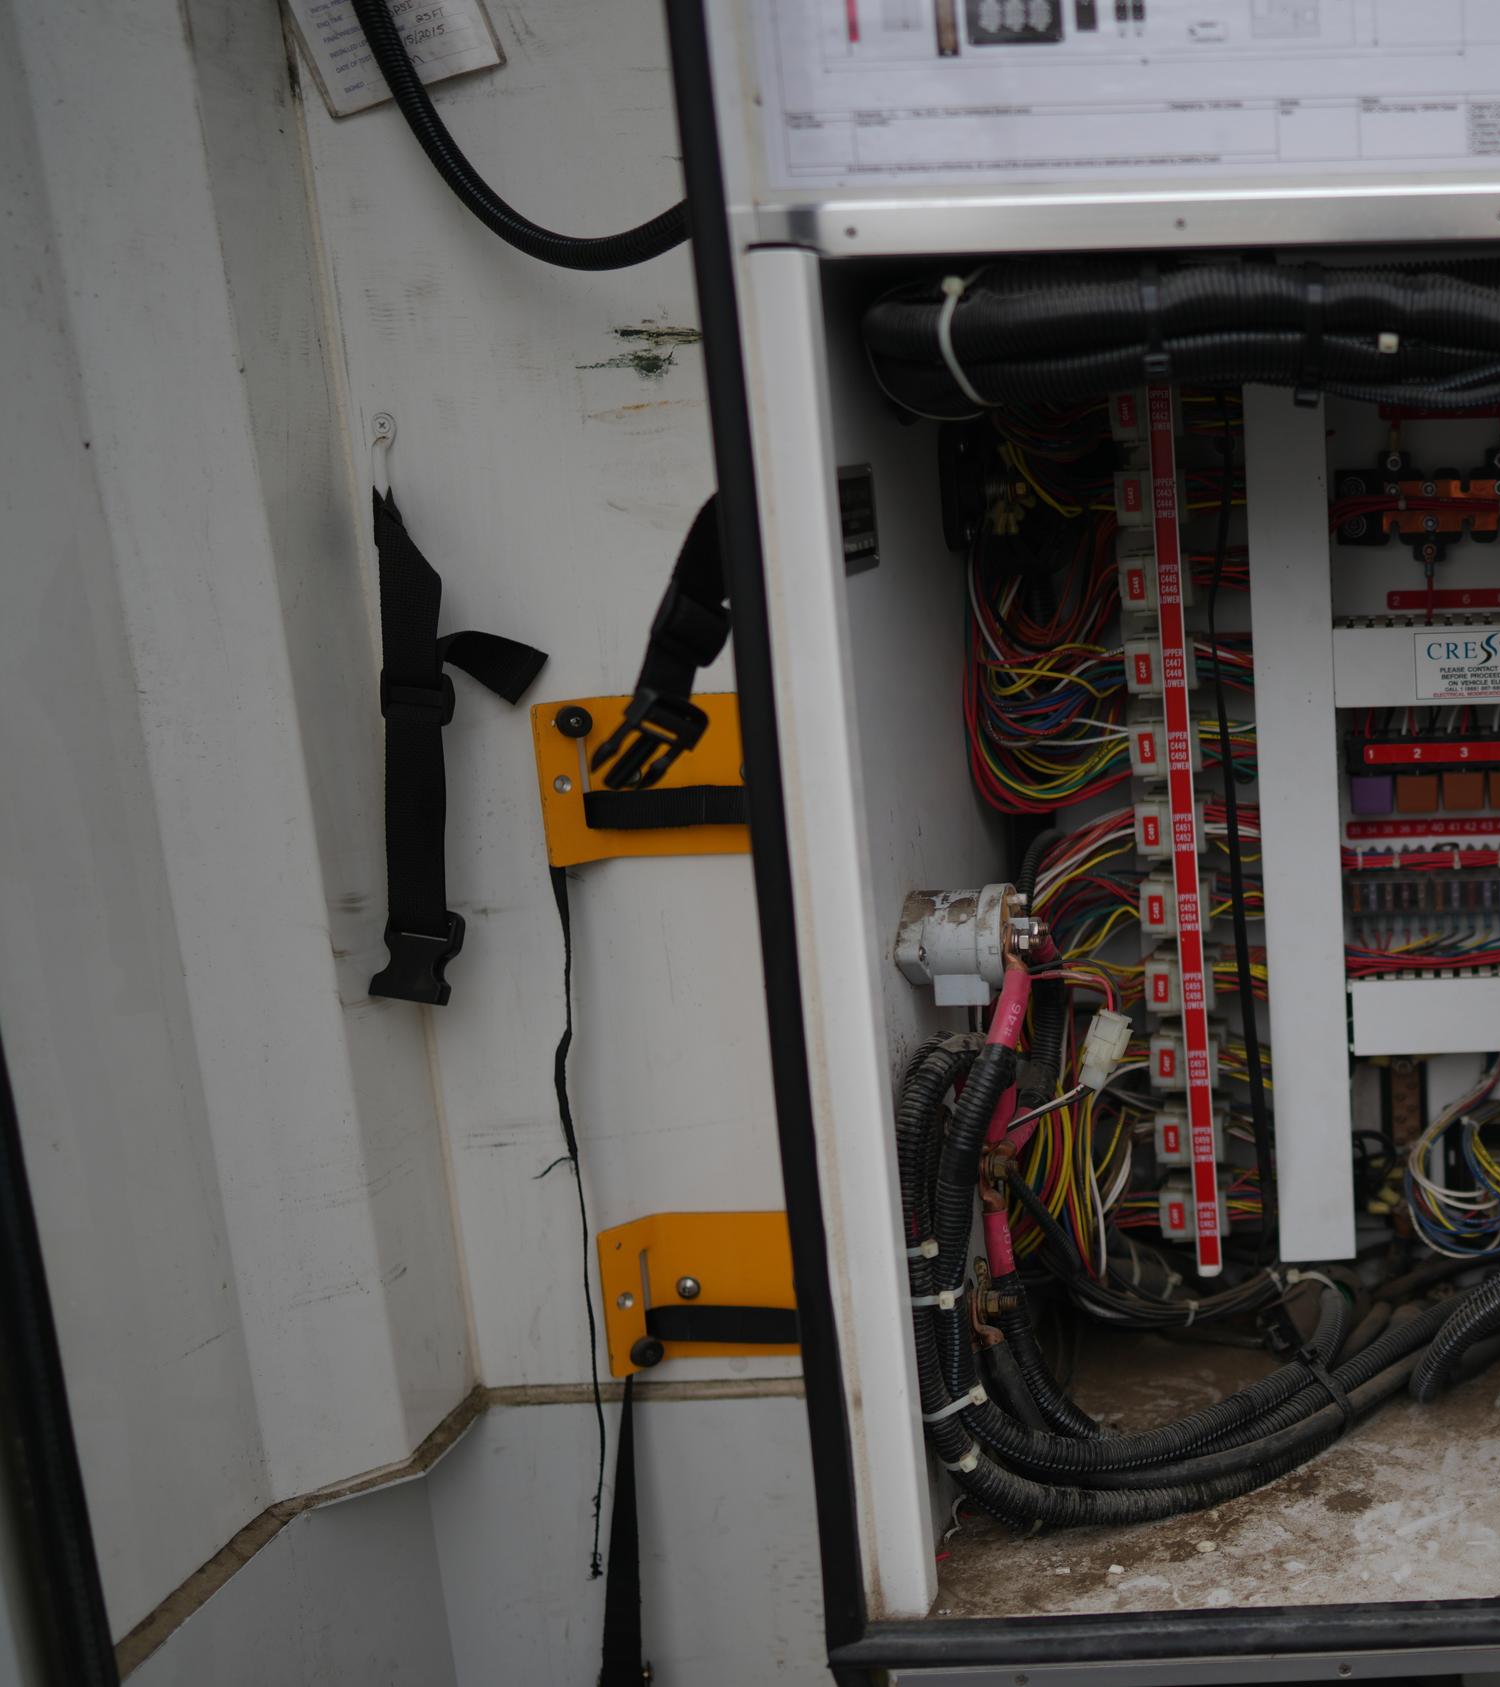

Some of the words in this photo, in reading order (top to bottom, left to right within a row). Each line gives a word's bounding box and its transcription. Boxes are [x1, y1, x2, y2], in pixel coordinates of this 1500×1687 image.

[1153, 479, 1174, 488] UPPER
[1158, 564, 1178, 573] UPPER
[1160, 574, 1177, 583] C445
[1161, 584, 1178, 594] C446
[1160, 595, 1180, 604] LOWER
[1392, 595, 1400, 606] 2
[1462, 593, 1470, 604] 6
[1163, 648, 1183, 657] UPPER
[1165, 658, 1181, 667] C447
[1165, 679, 1185, 688] LOWER
[1168, 731, 1187, 740] UPPER
[1369, 749, 1374, 760] 1
[1413, 748, 1422, 759] 2
[1460, 747, 1469, 758] 3
[1170, 761, 1190, 770] LOWER
[1173, 813, 1192, 822] UPPER
[1176, 833, 1192, 841] C452
[1177, 894, 1197, 902] UPPER
